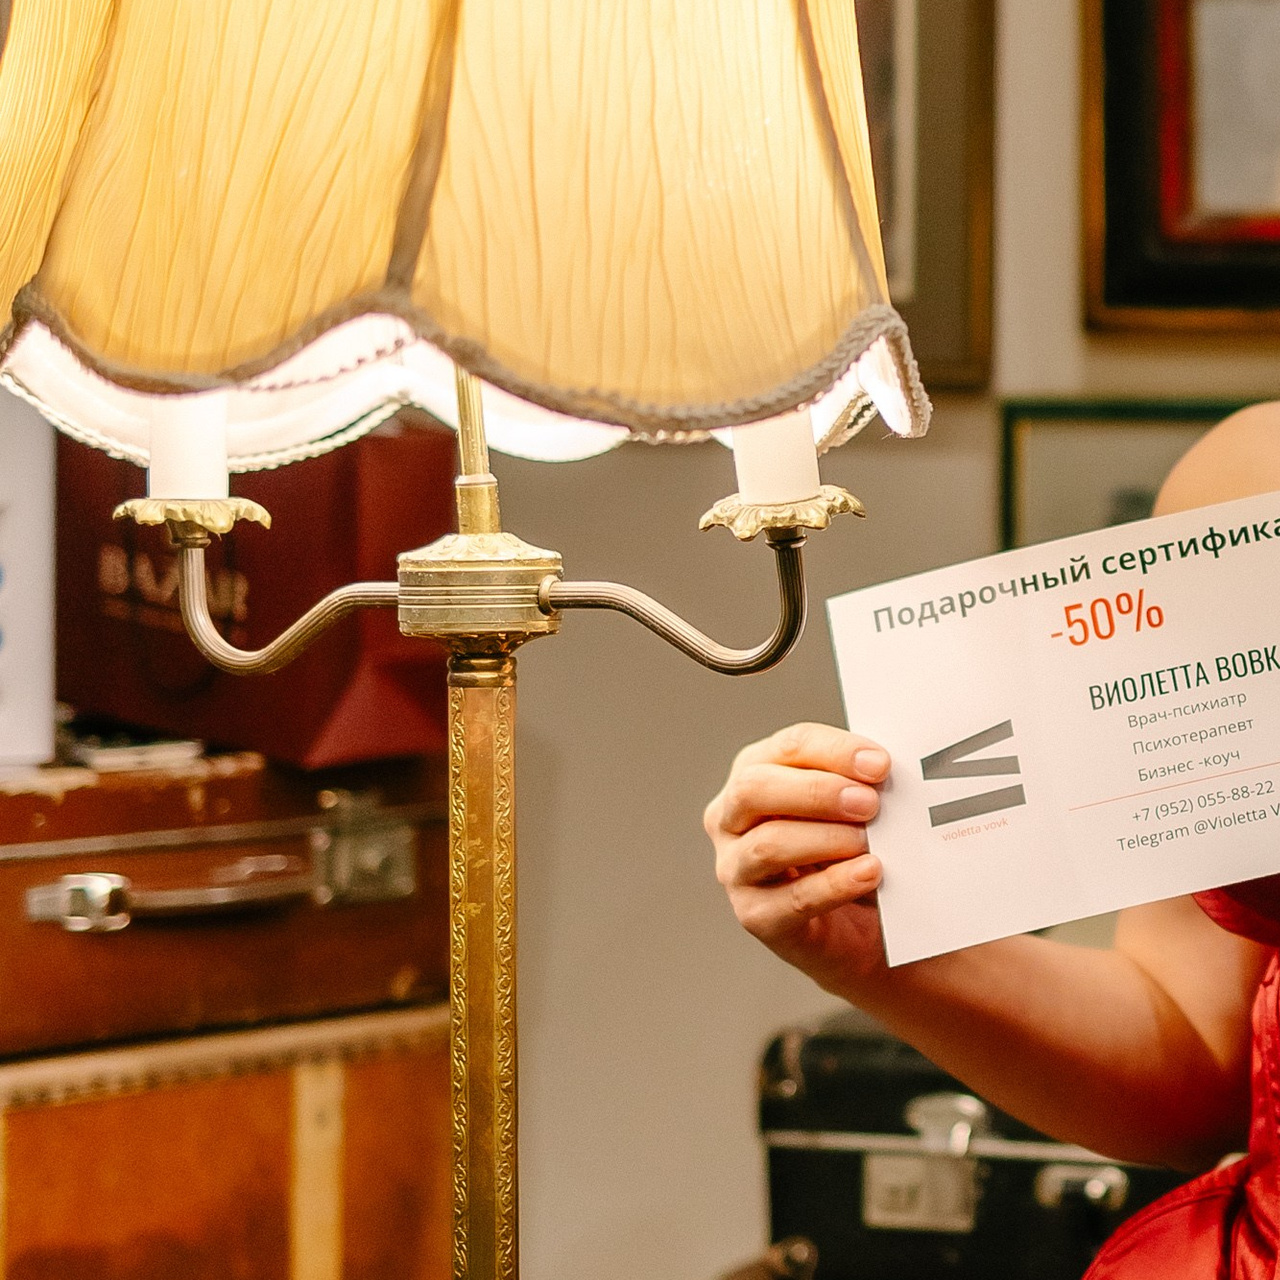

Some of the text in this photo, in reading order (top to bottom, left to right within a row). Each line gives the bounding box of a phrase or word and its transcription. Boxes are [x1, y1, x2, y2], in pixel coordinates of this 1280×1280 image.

[874, 555, 1091, 632] Подарочный
[1052, 589, 1164, 646] -50%
[1089, 645, 1280, 710] ВИОЛЕТТА ВОВК
[1127, 693, 1247, 729] Врач-психиатр
[1133, 719, 1253, 755] Психотерапевт
[1138, 750, 1240, 782] Бизнес -коуч
[1132, 780, 1275, 821] +7 (952) 055-88-22
[1116, 826, 1190, 851] Telegram
[1194, 809, 1267, 835] @Violetta
